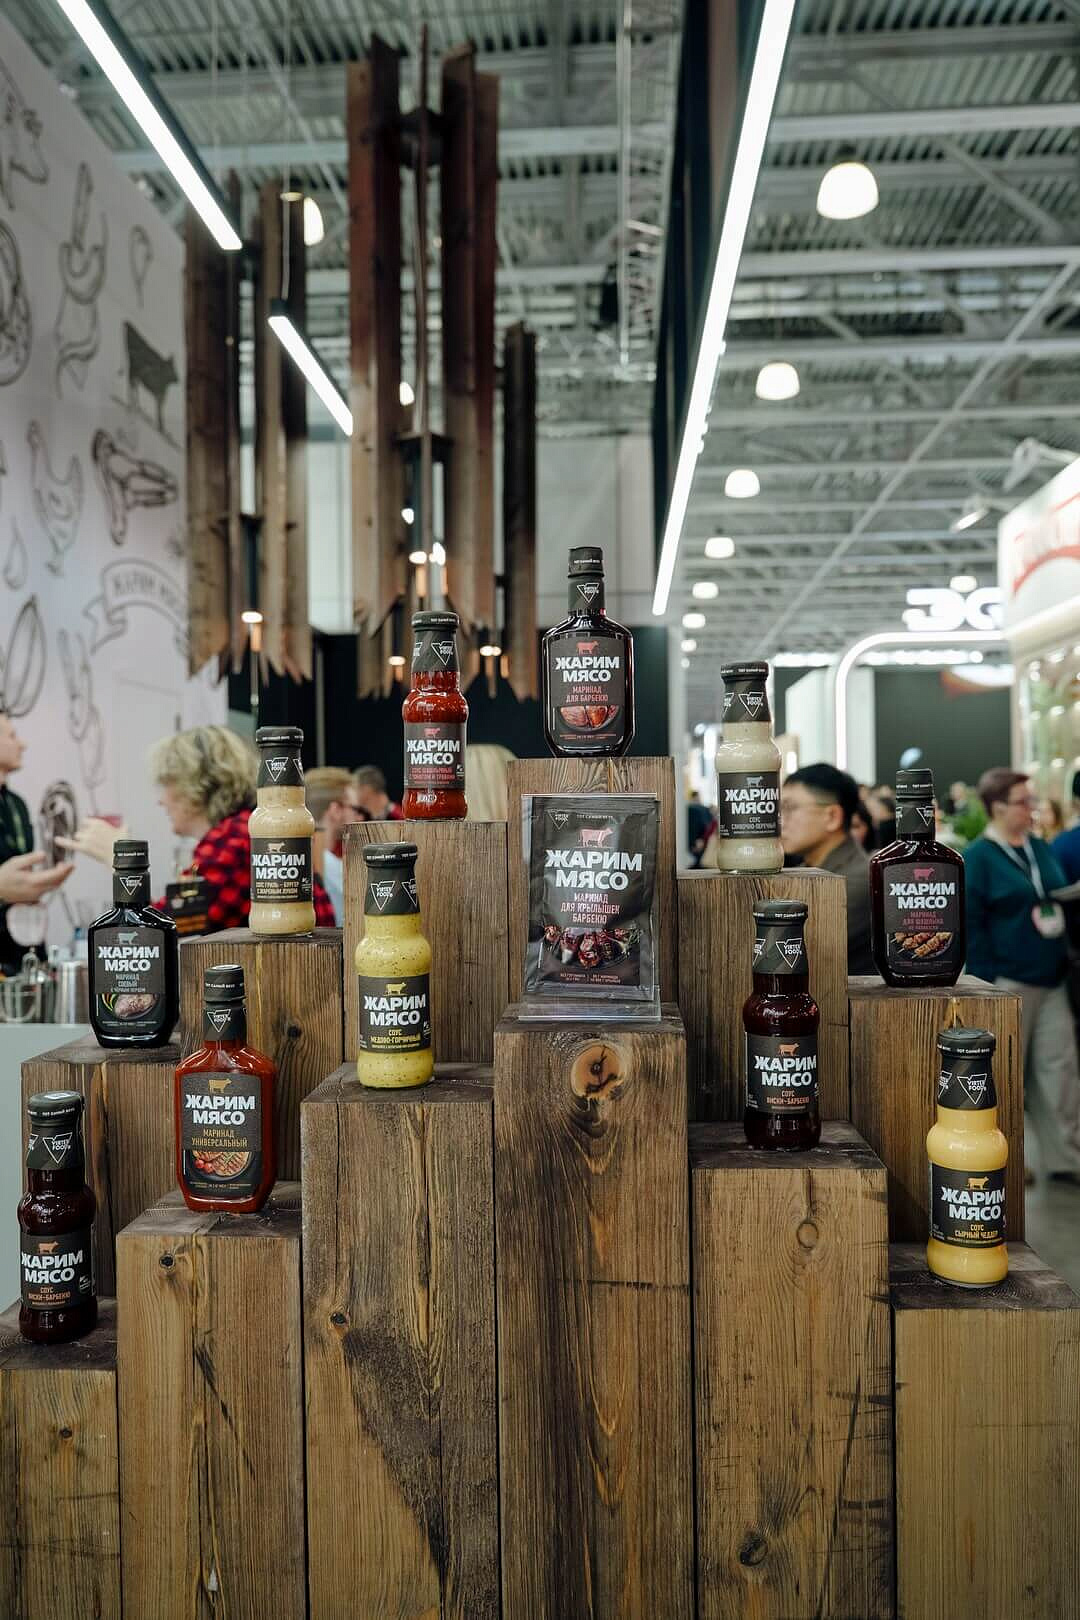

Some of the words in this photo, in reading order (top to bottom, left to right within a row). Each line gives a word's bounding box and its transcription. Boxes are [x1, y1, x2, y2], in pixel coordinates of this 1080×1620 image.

[556, 656, 620, 670] ЖАРИМ
[563, 670, 611, 682] МЯСО
[407, 740, 460, 752] ЖАРИМ
[410, 753, 454, 765] МЯСО
[724, 788, 779, 801] ЖАРИМ
[732, 801, 775, 814] МЯСО
[252, 854, 305, 866] ЖАРИМ
[544, 850, 642, 871] ЖАРИМ
[256, 867, 299, 879] МЯСО
[556, 870, 629, 890] МЯСО
[889, 882, 955, 895] ЖАРИМ
[574, 892, 608, 903] МАРИНАД
[898, 896, 948, 909] МЯСО
[560, 902, 576, 912] ДЛЯ
[577, 903, 620, 914] КРЫЛЫШЕК
[572, 913, 607, 924] БАРБЕКЮ
[98, 946, 160, 958] ЖАРИМ
[105, 959, 151, 972] МЯСО
[364, 994, 426, 1011] ЖАРИМ
[370, 1010, 420, 1026] МЯСО
[754, 1054, 816, 1071] ЖАРИМ
[762, 1072, 812, 1086] МЯСО
[185, 1094, 255, 1110] ЖАРИМ
[193, 1110, 245, 1125] МЯСО
[203, 1129, 234, 1138] МАРИНАД
[192, 1137, 247, 1148] УНИВЕРСАЛЬНЫЙ
[941, 1186, 1005, 1205] ЖАРИМ
[949, 1204, 1001, 1221] МЯСО
[954, 1230, 979, 1238] СЫРНЫЙ
[21, 1249, 83, 1269] ЖАРИМ
[25, 1267, 75, 1284] МЯСО
